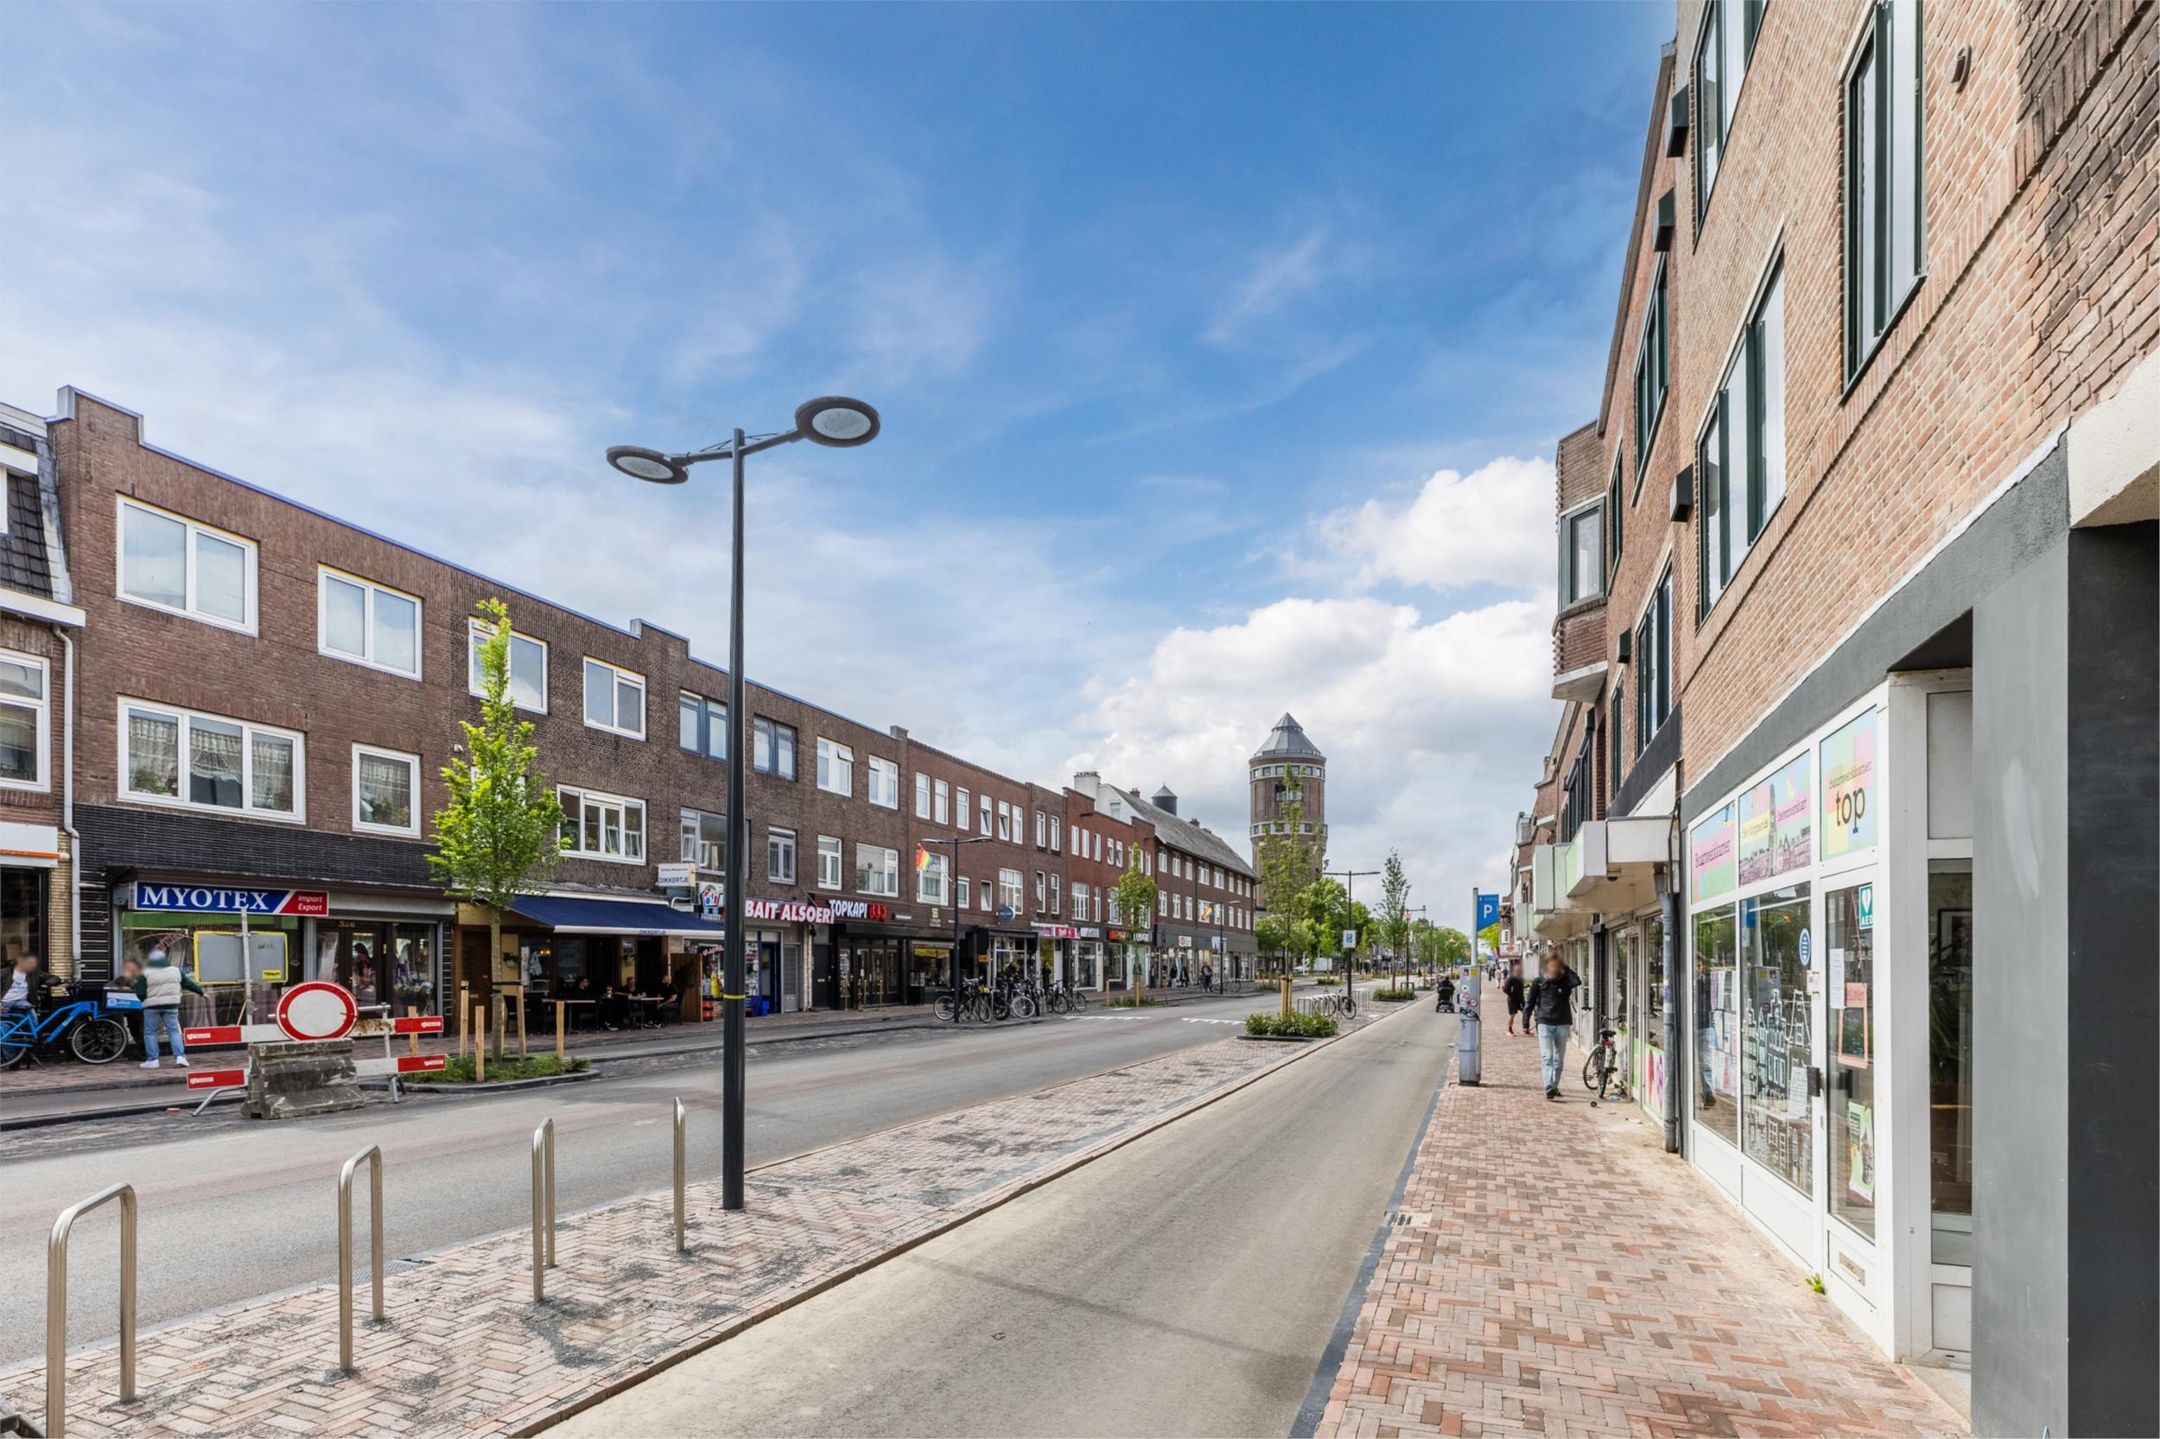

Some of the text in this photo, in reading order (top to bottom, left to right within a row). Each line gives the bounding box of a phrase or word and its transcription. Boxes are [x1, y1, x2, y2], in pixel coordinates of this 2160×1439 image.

[1835, 787, 1866, 834] top
[142, 885, 270, 910] MYOTEX
[298, 903, 323, 912] Export
[828, 899, 869, 919] TOPKAPI
[1483, 904, 1493, 919] P
